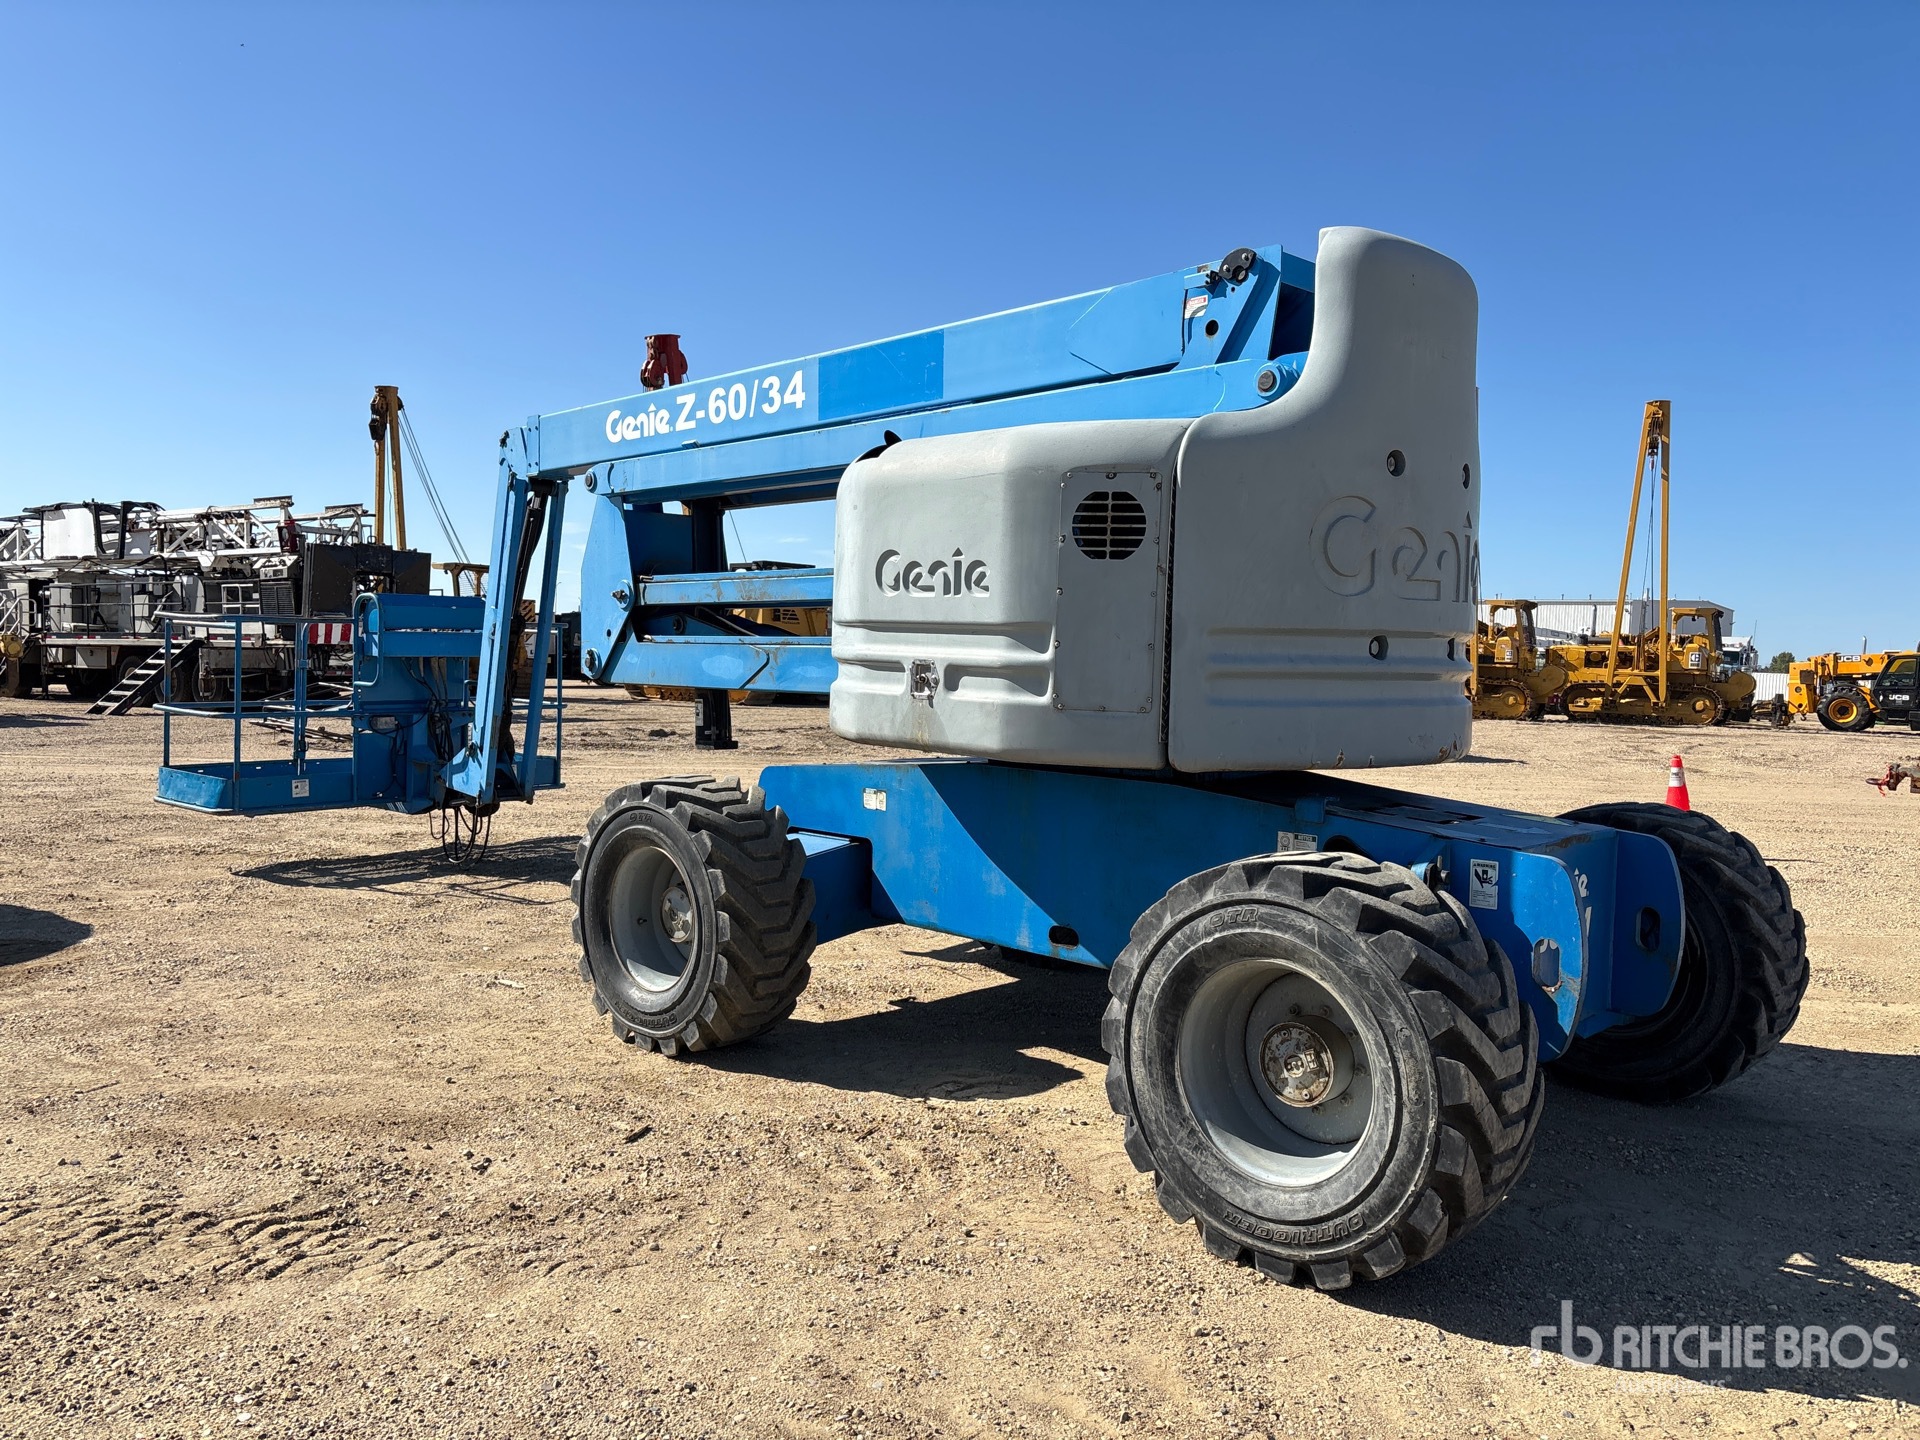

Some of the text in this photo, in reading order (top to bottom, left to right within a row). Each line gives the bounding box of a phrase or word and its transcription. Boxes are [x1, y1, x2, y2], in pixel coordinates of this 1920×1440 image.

[605, 370, 806, 443] Genie Z-60/34
[875, 547, 990, 598] Genie
[1223, 1210, 1366, 1244] OUTRIGGER
